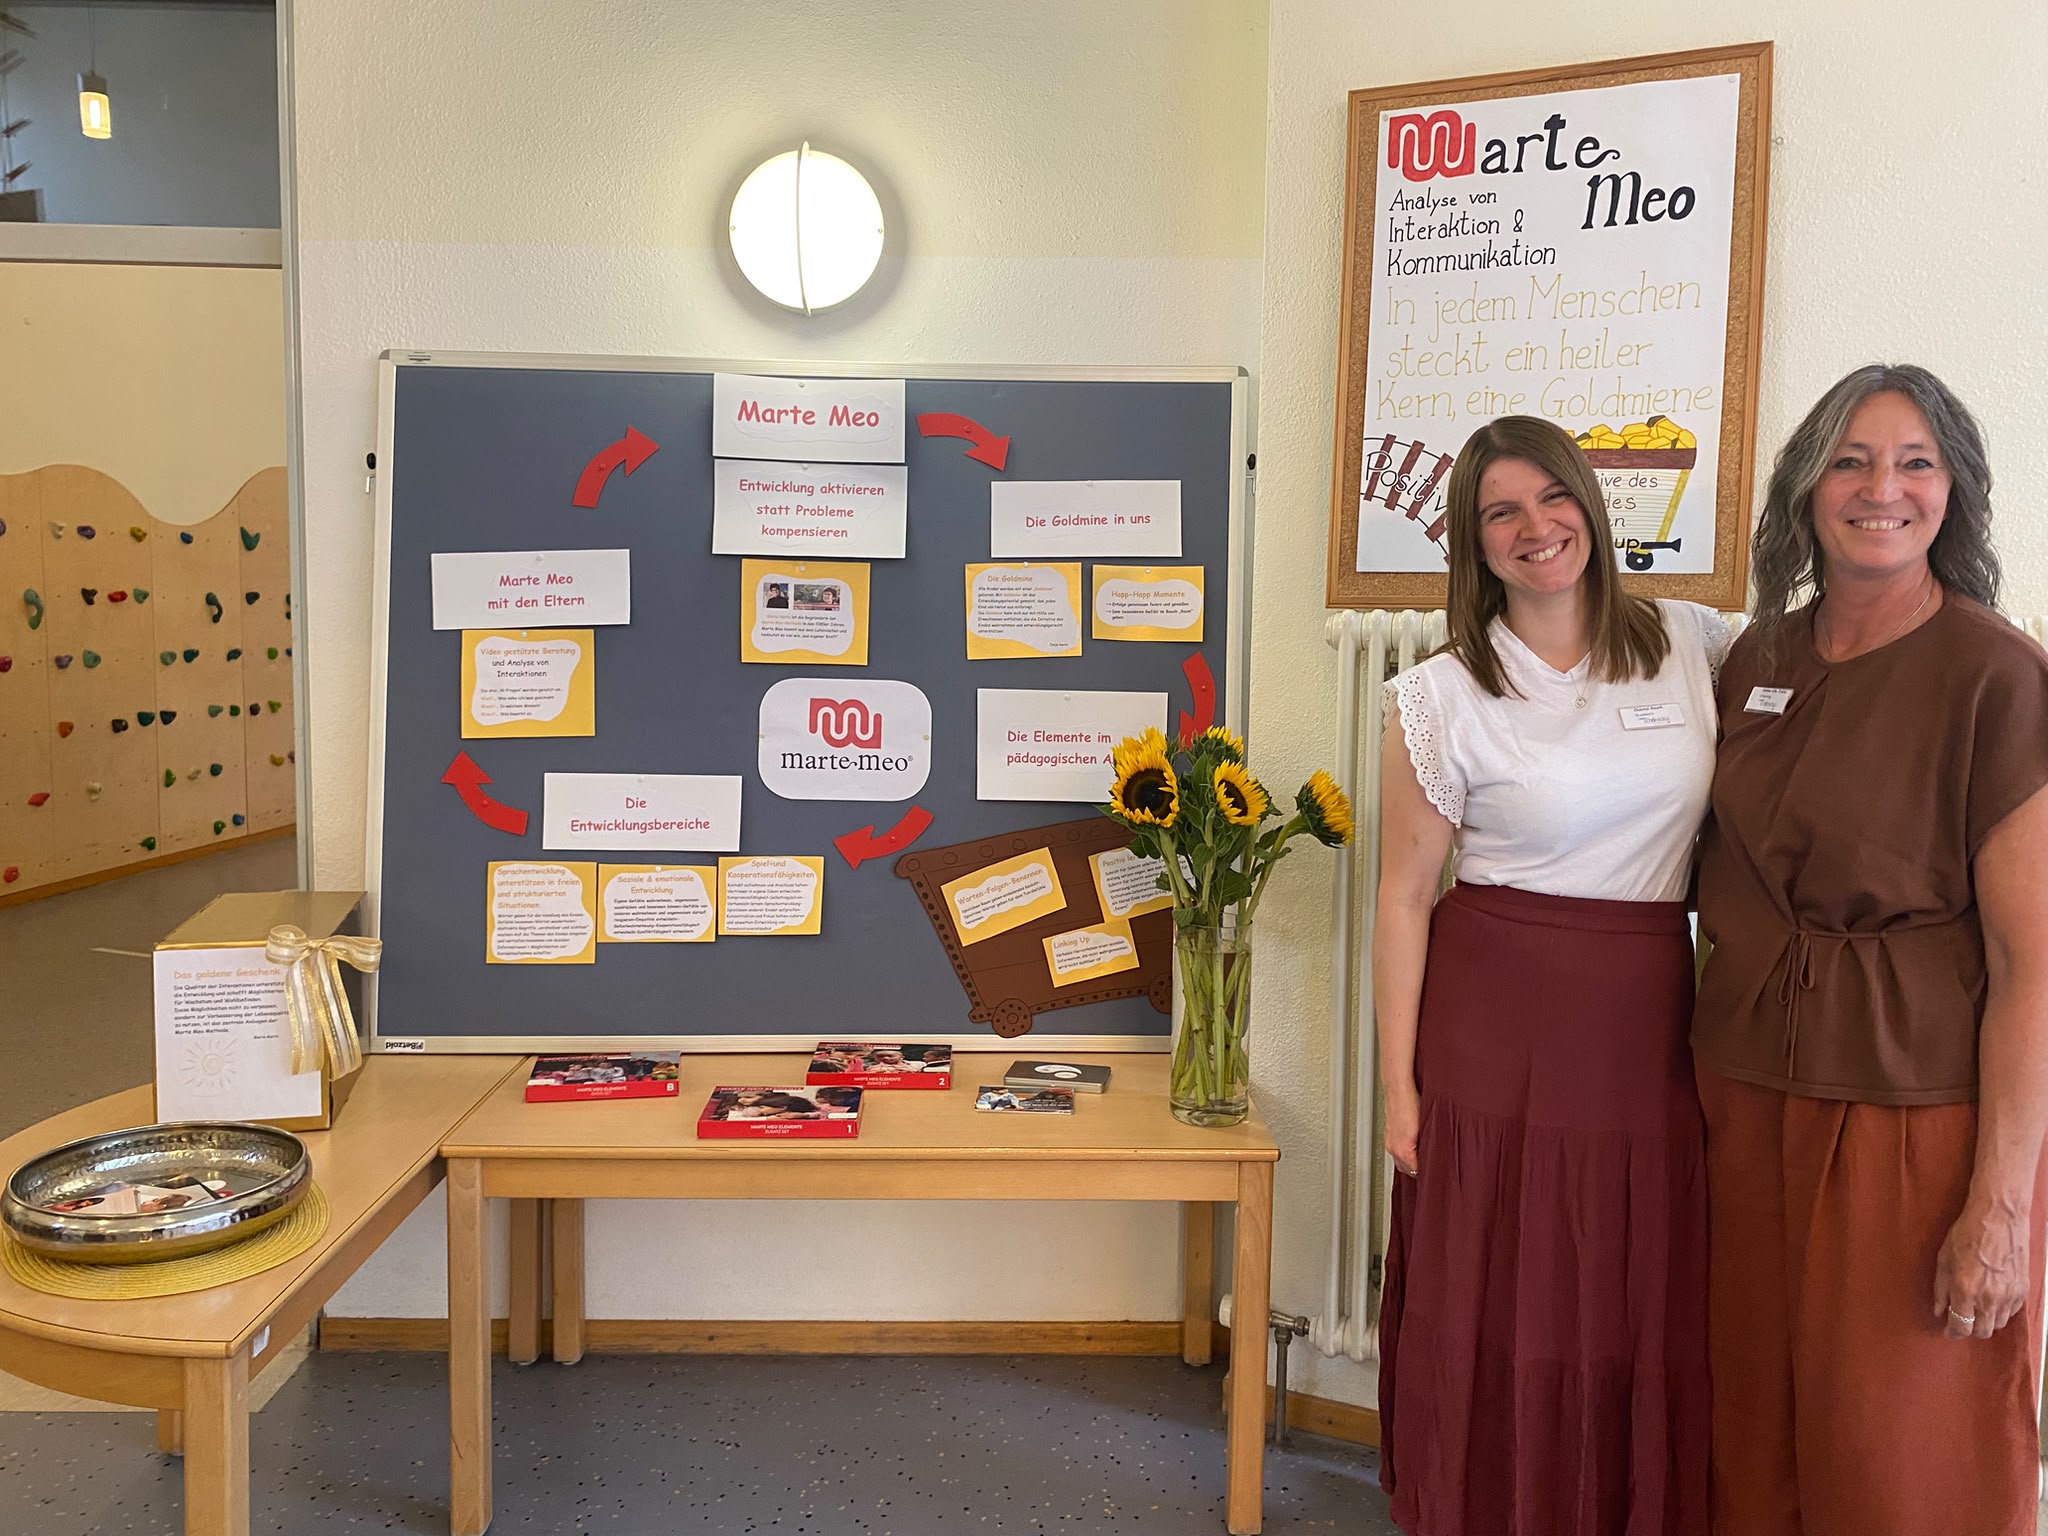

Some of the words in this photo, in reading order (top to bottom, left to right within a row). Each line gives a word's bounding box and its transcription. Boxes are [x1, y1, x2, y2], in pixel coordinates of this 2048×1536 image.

[1389, 188, 1458, 216] Analyse
[1469, 190, 1497, 206] von
[1581, 171, 1696, 230] Meo
[1388, 211, 1500, 243] Interaktion
[1513, 209, 1524, 233] &
[1387, 239, 1556, 277] Kommunikation
[1386, 286, 1417, 326] In
[1428, 281, 1516, 344] jedem
[1527, 271, 1702, 320] Menschen
[1386, 331, 1489, 379] steckt
[1504, 341, 1548, 372] ein
[1559, 327, 1653, 370] heiler
[1376, 379, 1456, 422] Kern,
[1466, 385, 1527, 416] eine
[1540, 376, 1715, 418] Goldmiene
[737, 400, 816, 426] Marte
[828, 405, 880, 428] Meo
[1366, 450, 1448, 514] Positiv
[1628, 471, 1658, 488] des
[739, 479, 815, 496] Entwicklung
[820, 482, 884, 496] aktivieren
[756, 504, 790, 515] statt
[795, 504, 854, 518] Probleme
[1025, 516, 1047, 528] Die
[1052, 514, 1108, 527] Goldmine
[1114, 514, 1125, 525] in
[1130, 514, 1151, 524] uns
[761, 525, 848, 539] kompensieren
[499, 575, 540, 587] Marte
[546, 573, 573, 585] Meo
[488, 597, 509, 609] mit
[515, 596, 539, 609] den
[544, 595, 585, 607] Eltern
[1111, 591, 1151, 599] Happ-Happ
[542, 648, 576, 656] Beratung
[492, 659, 505, 667] und
[507, 659, 535, 668] Analyse
[497, 670, 547, 678] Interaktionen
[1007, 730, 1028, 742] Die
[1033, 730, 1092, 743] Elemente
[1097, 731, 1112, 744] im
[1007, 753, 1097, 767] pädagogischen
[625, 797, 647, 809] Die
[570, 818, 711, 834] Entwicklungsbereiche
[617, 875, 644, 883] Soziale
[727, 871, 815, 880] Kooperationsfähigkeiten
[630, 886, 674, 895] Entwicklung
[1053, 938, 1078, 949] Linking
[1080, 936, 1090, 945] Up
[174, 971, 192, 979] Das
[195, 970, 232, 980] goldene
[236, 968, 281, 977] Geschenk
[666, 1083, 675, 1092] B
[938, 1078, 945, 1086] 2
[847, 1124, 852, 1133] 1
